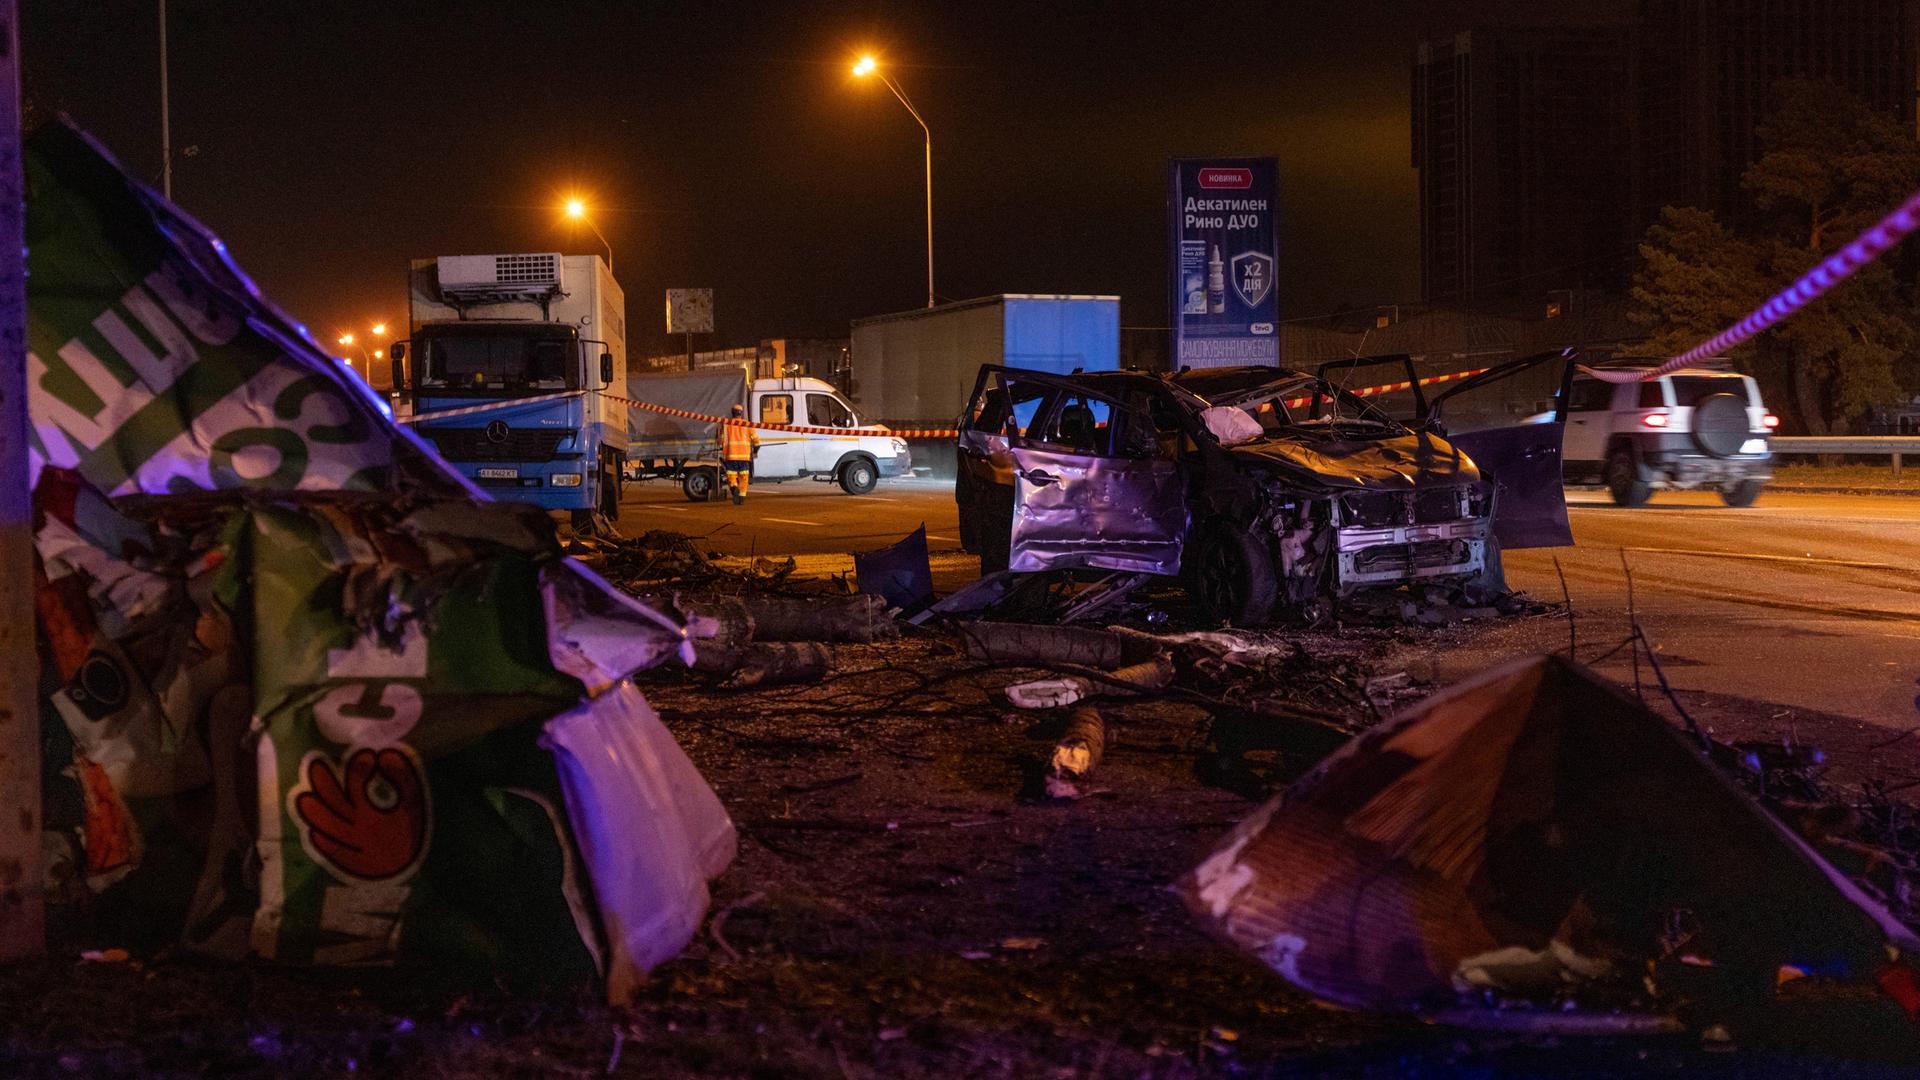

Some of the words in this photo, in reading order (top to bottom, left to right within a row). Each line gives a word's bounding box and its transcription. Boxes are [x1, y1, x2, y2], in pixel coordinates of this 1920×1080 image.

[1208, 174, 1243, 183] НОВИНКА
[1184, 196, 1268, 213] Декатилен
[1185, 214, 1223, 229] Рино
[1227, 214, 1259, 231] ДУО
[1242, 278, 1261, 293] ДІЯ
